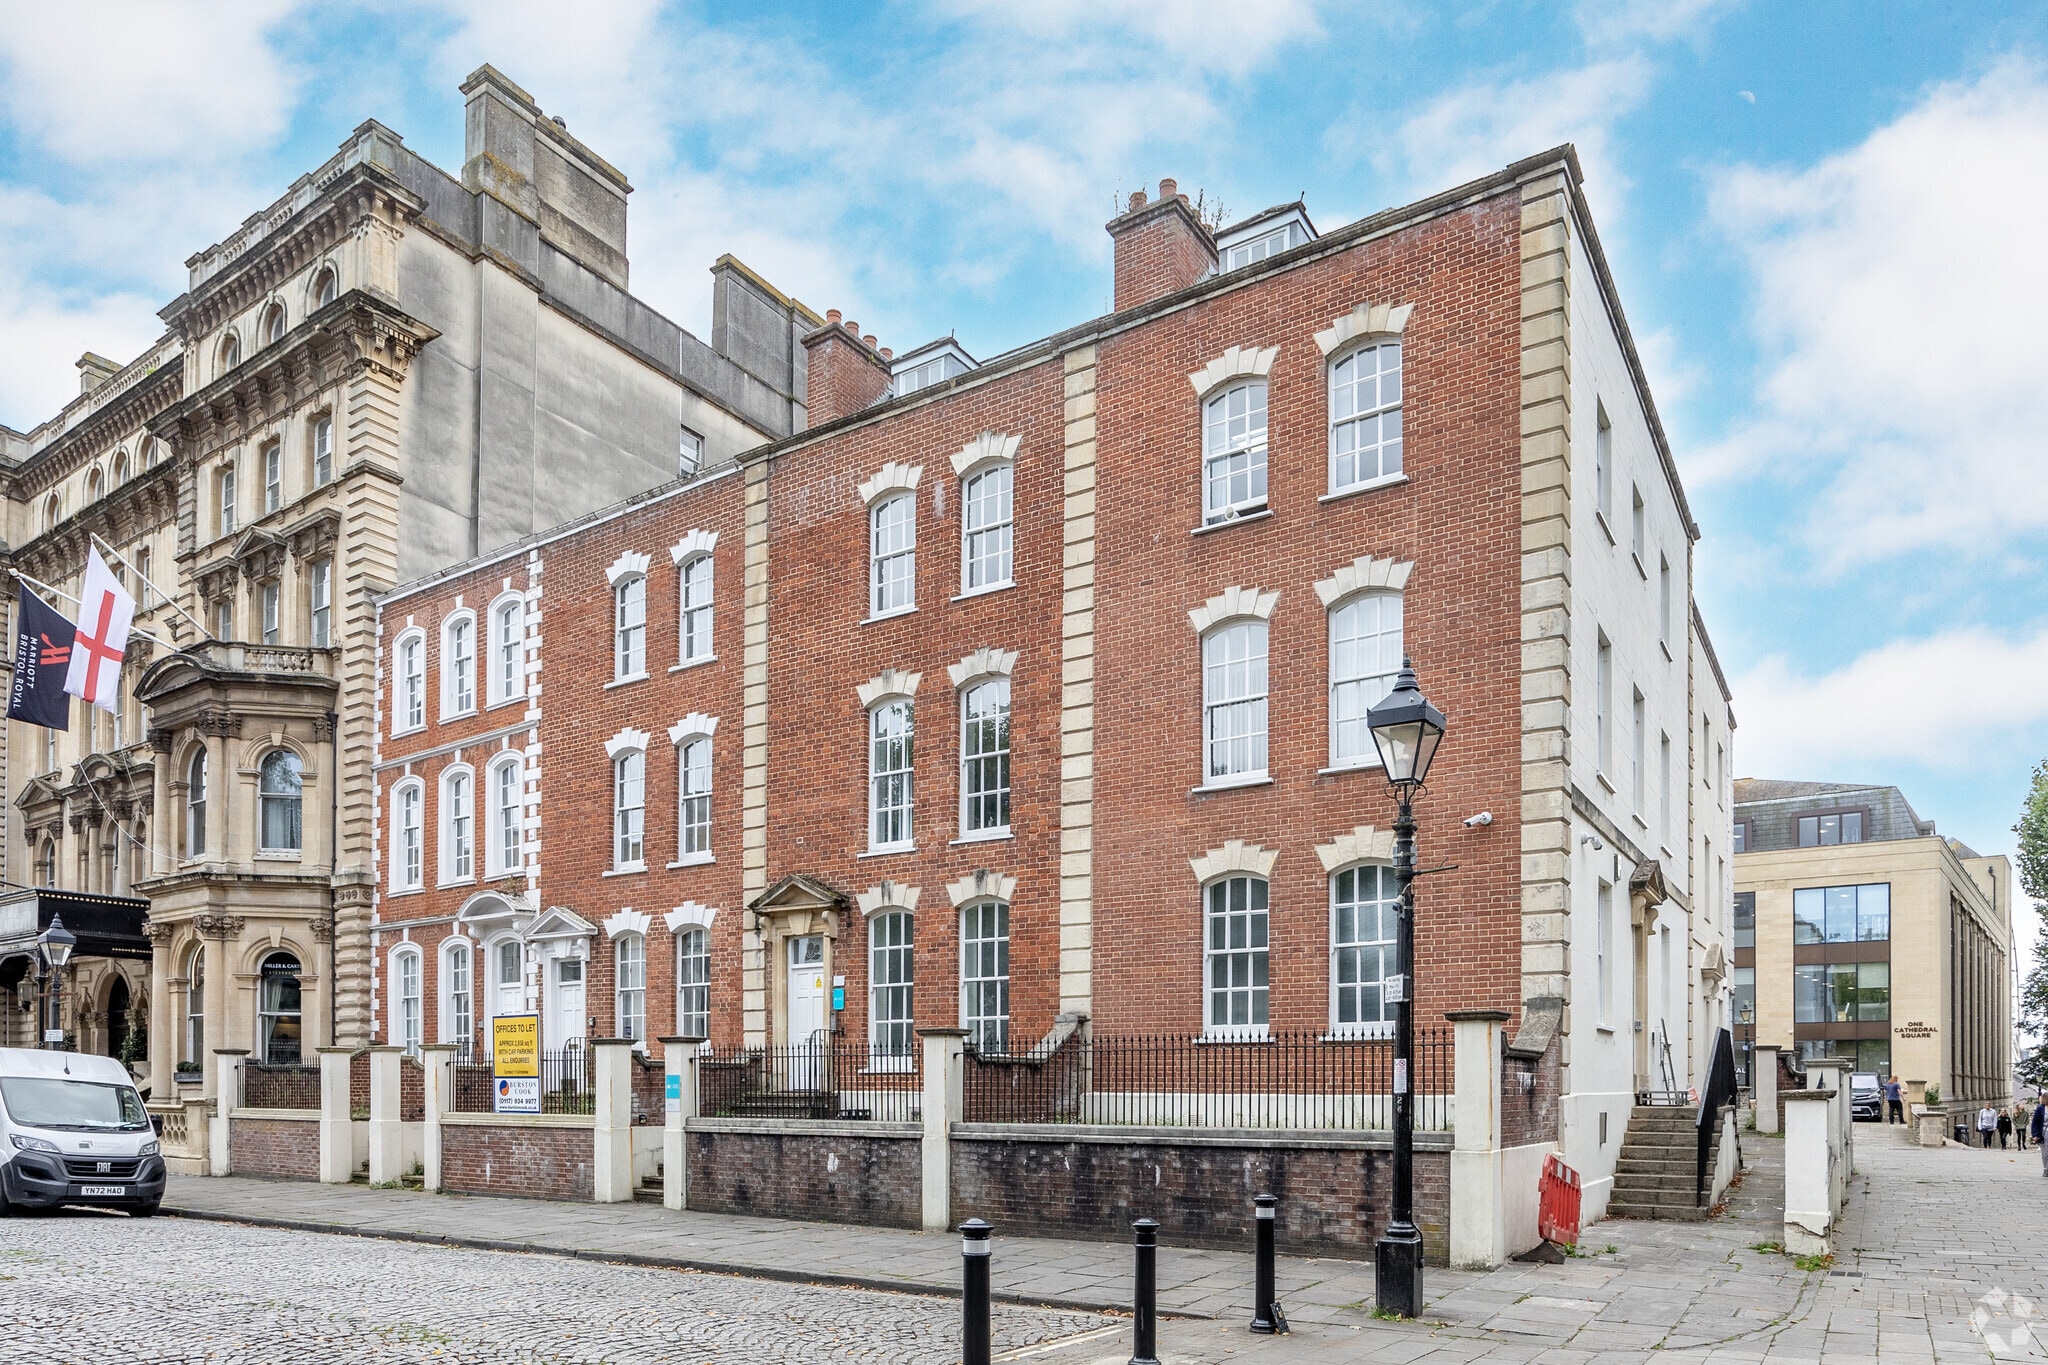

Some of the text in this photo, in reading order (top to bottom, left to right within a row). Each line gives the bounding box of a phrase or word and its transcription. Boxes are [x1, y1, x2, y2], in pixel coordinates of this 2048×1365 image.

[13, 634, 28, 709] BRISTOL ROYAL
[27, 637, 38, 689] MARRIOTT
[496, 1023, 536, 1033] OFFICES TO LET
[96, 1162, 111, 1173] FIAT
